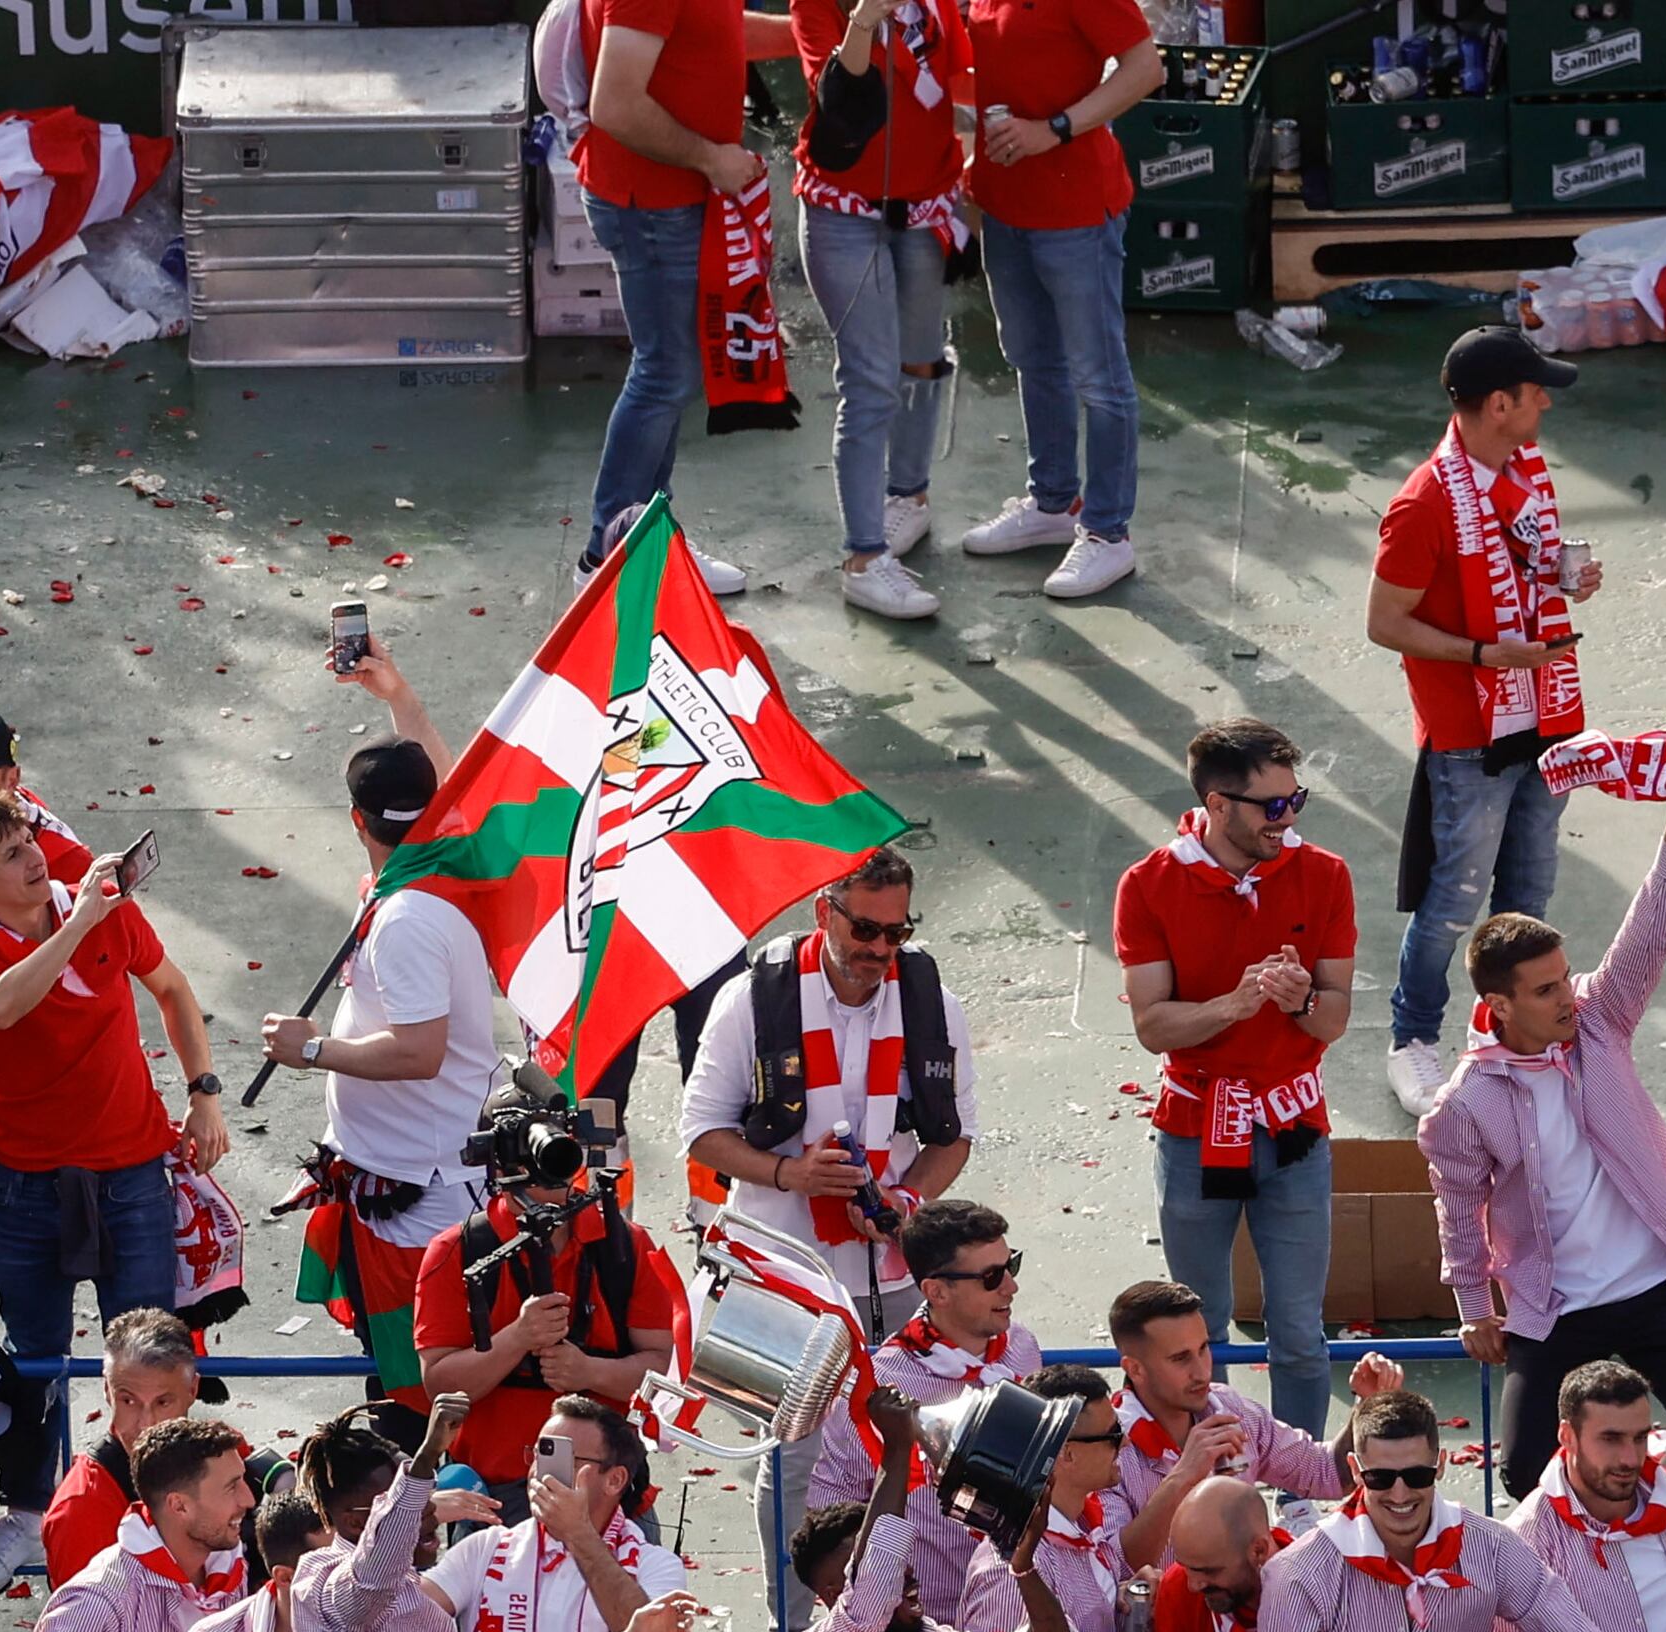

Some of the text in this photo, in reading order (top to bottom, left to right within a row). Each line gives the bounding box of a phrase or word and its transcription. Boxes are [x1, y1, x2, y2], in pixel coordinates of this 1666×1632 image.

[724, 311, 780, 363] 25
[649, 652, 745, 770] ATHLETIC CLUB
